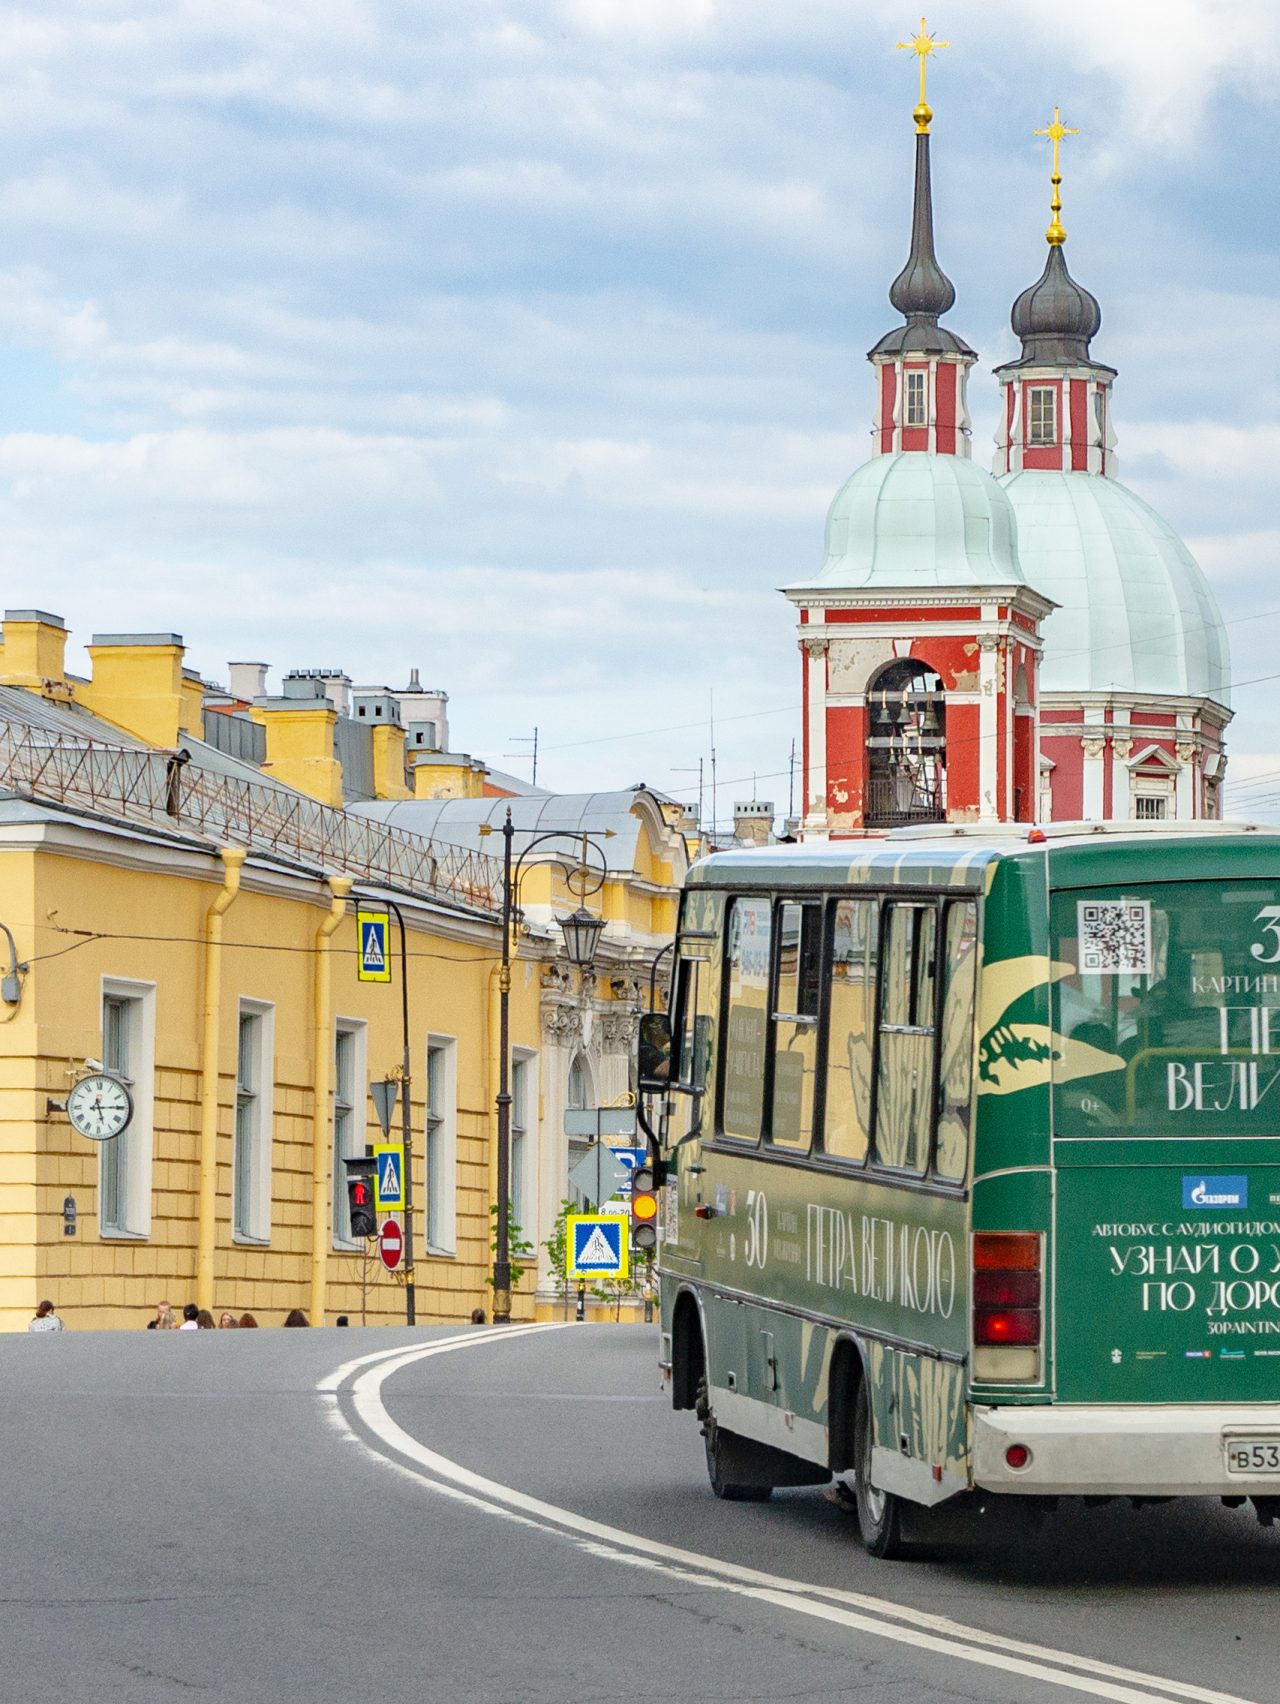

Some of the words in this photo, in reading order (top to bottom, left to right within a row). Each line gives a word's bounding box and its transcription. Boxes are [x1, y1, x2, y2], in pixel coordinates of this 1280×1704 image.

[1192, 975, 1278, 993] КАРТИН
[1081, 1098, 1100, 1112] 0+
[745, 1189, 768, 1270] 30
[1092, 1223, 1160, 1237] АВТОБУС
[1162, 1223, 1174, 1237] С
[807, 1204, 858, 1294] ПЕТРА
[862, 1215, 956, 1320] ВЕЛИКОГО
[1110, 1244, 1219, 1276] УЗНАЙ
[1229, 1243, 1260, 1273] О
[1143, 1281, 1196, 1311] ПО
